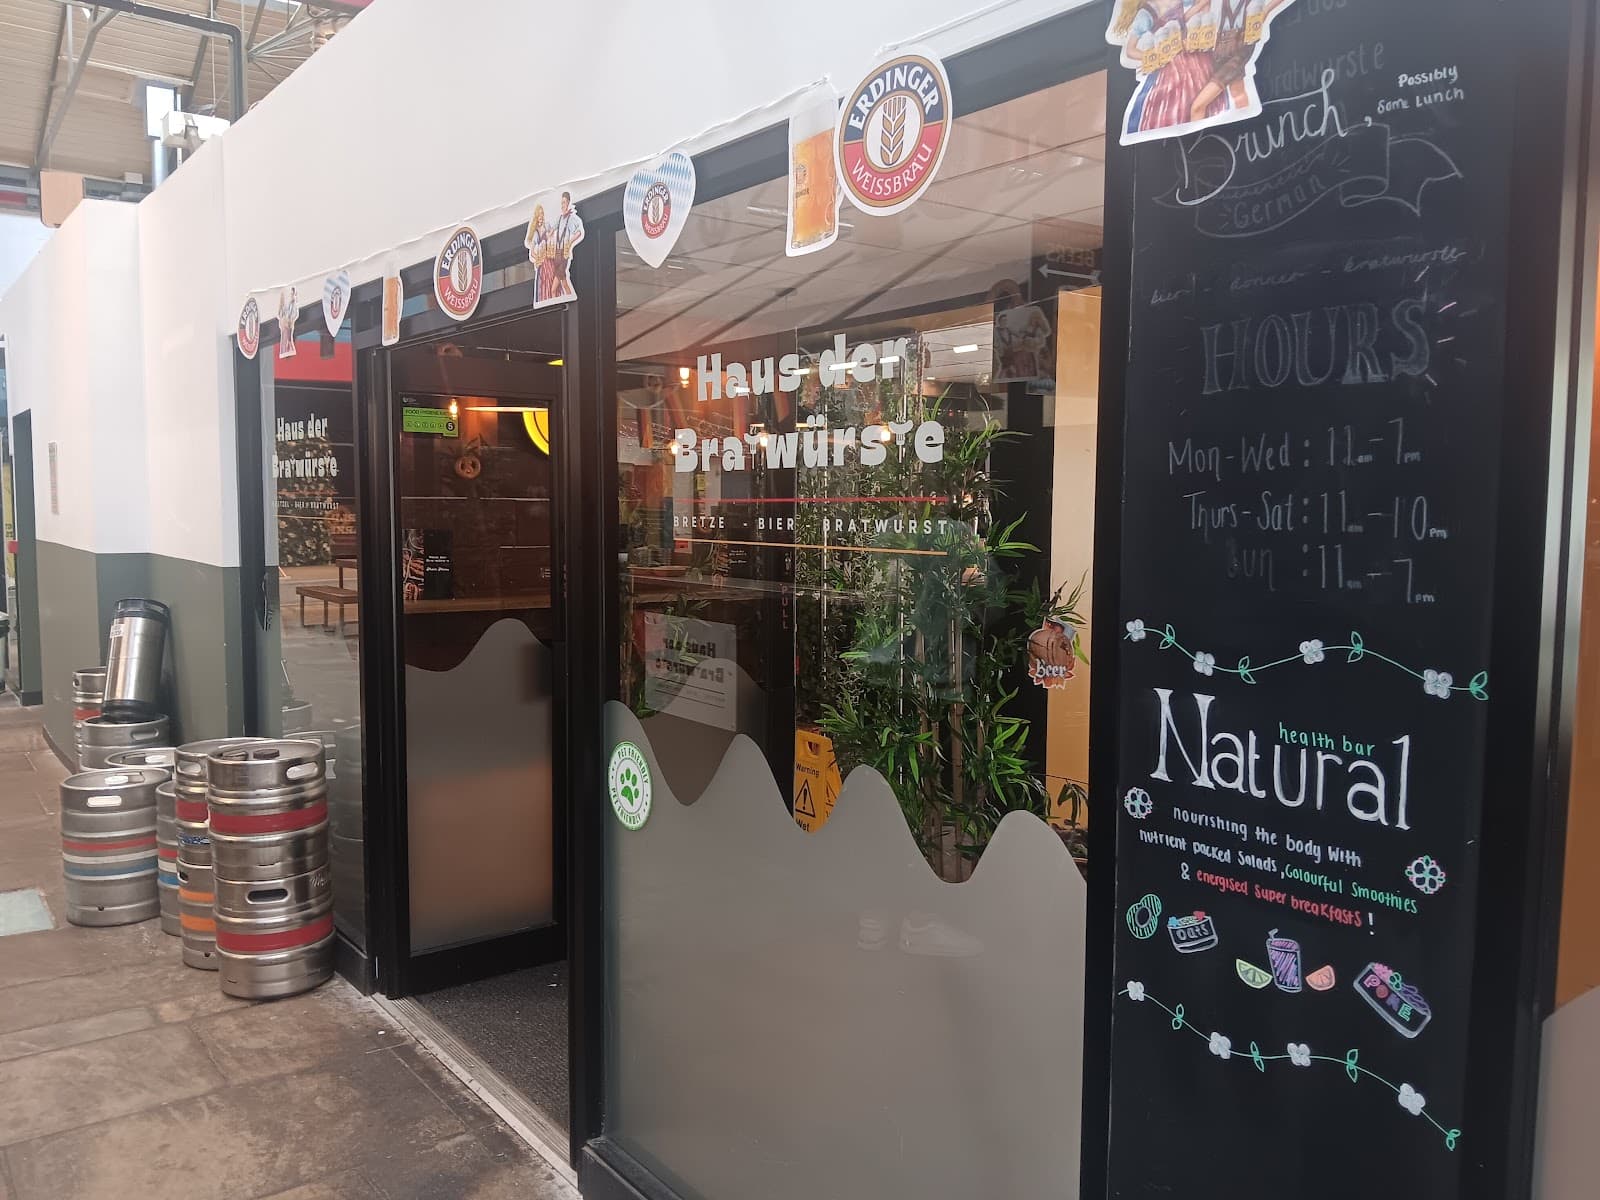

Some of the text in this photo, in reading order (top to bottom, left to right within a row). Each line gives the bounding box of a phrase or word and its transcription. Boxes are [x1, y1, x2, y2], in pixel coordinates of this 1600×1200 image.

[1398, 65, 1458, 87] Possibly
[848, 64, 939, 131] ERDINGER
[851, 143, 934, 197] WEISSBRÄU
[1233, 174, 1328, 229] German
[441, 233, 478, 271] ERDINGER
[1200, 298, 1431, 395] HOURS
[696, 333, 909, 401] Haus der
[277, 413, 328, 441] Haus der
[446, 422, 454, 431] 5
[1168, 432, 1291, 481] Mon-Wed
[673, 515, 726, 529] BRETZE
[758, 517, 795, 530] BIER
[823, 518, 948, 535] BRATWURST
[1182, 490, 1296, 545] Thurs-Sat
[1035, 658, 1067, 678] Beer
[1279, 722, 1376, 757] health bar
[796, 761, 820, 778] Warning
[1150, 688, 1411, 831] Natural
[1139, 829, 1187, 852] nutrient
[1173, 807, 1248, 842] nourishing
[1255, 827, 1277, 845] the
[1286, 835, 1321, 863] body
[1180, 862, 1191, 881] &
